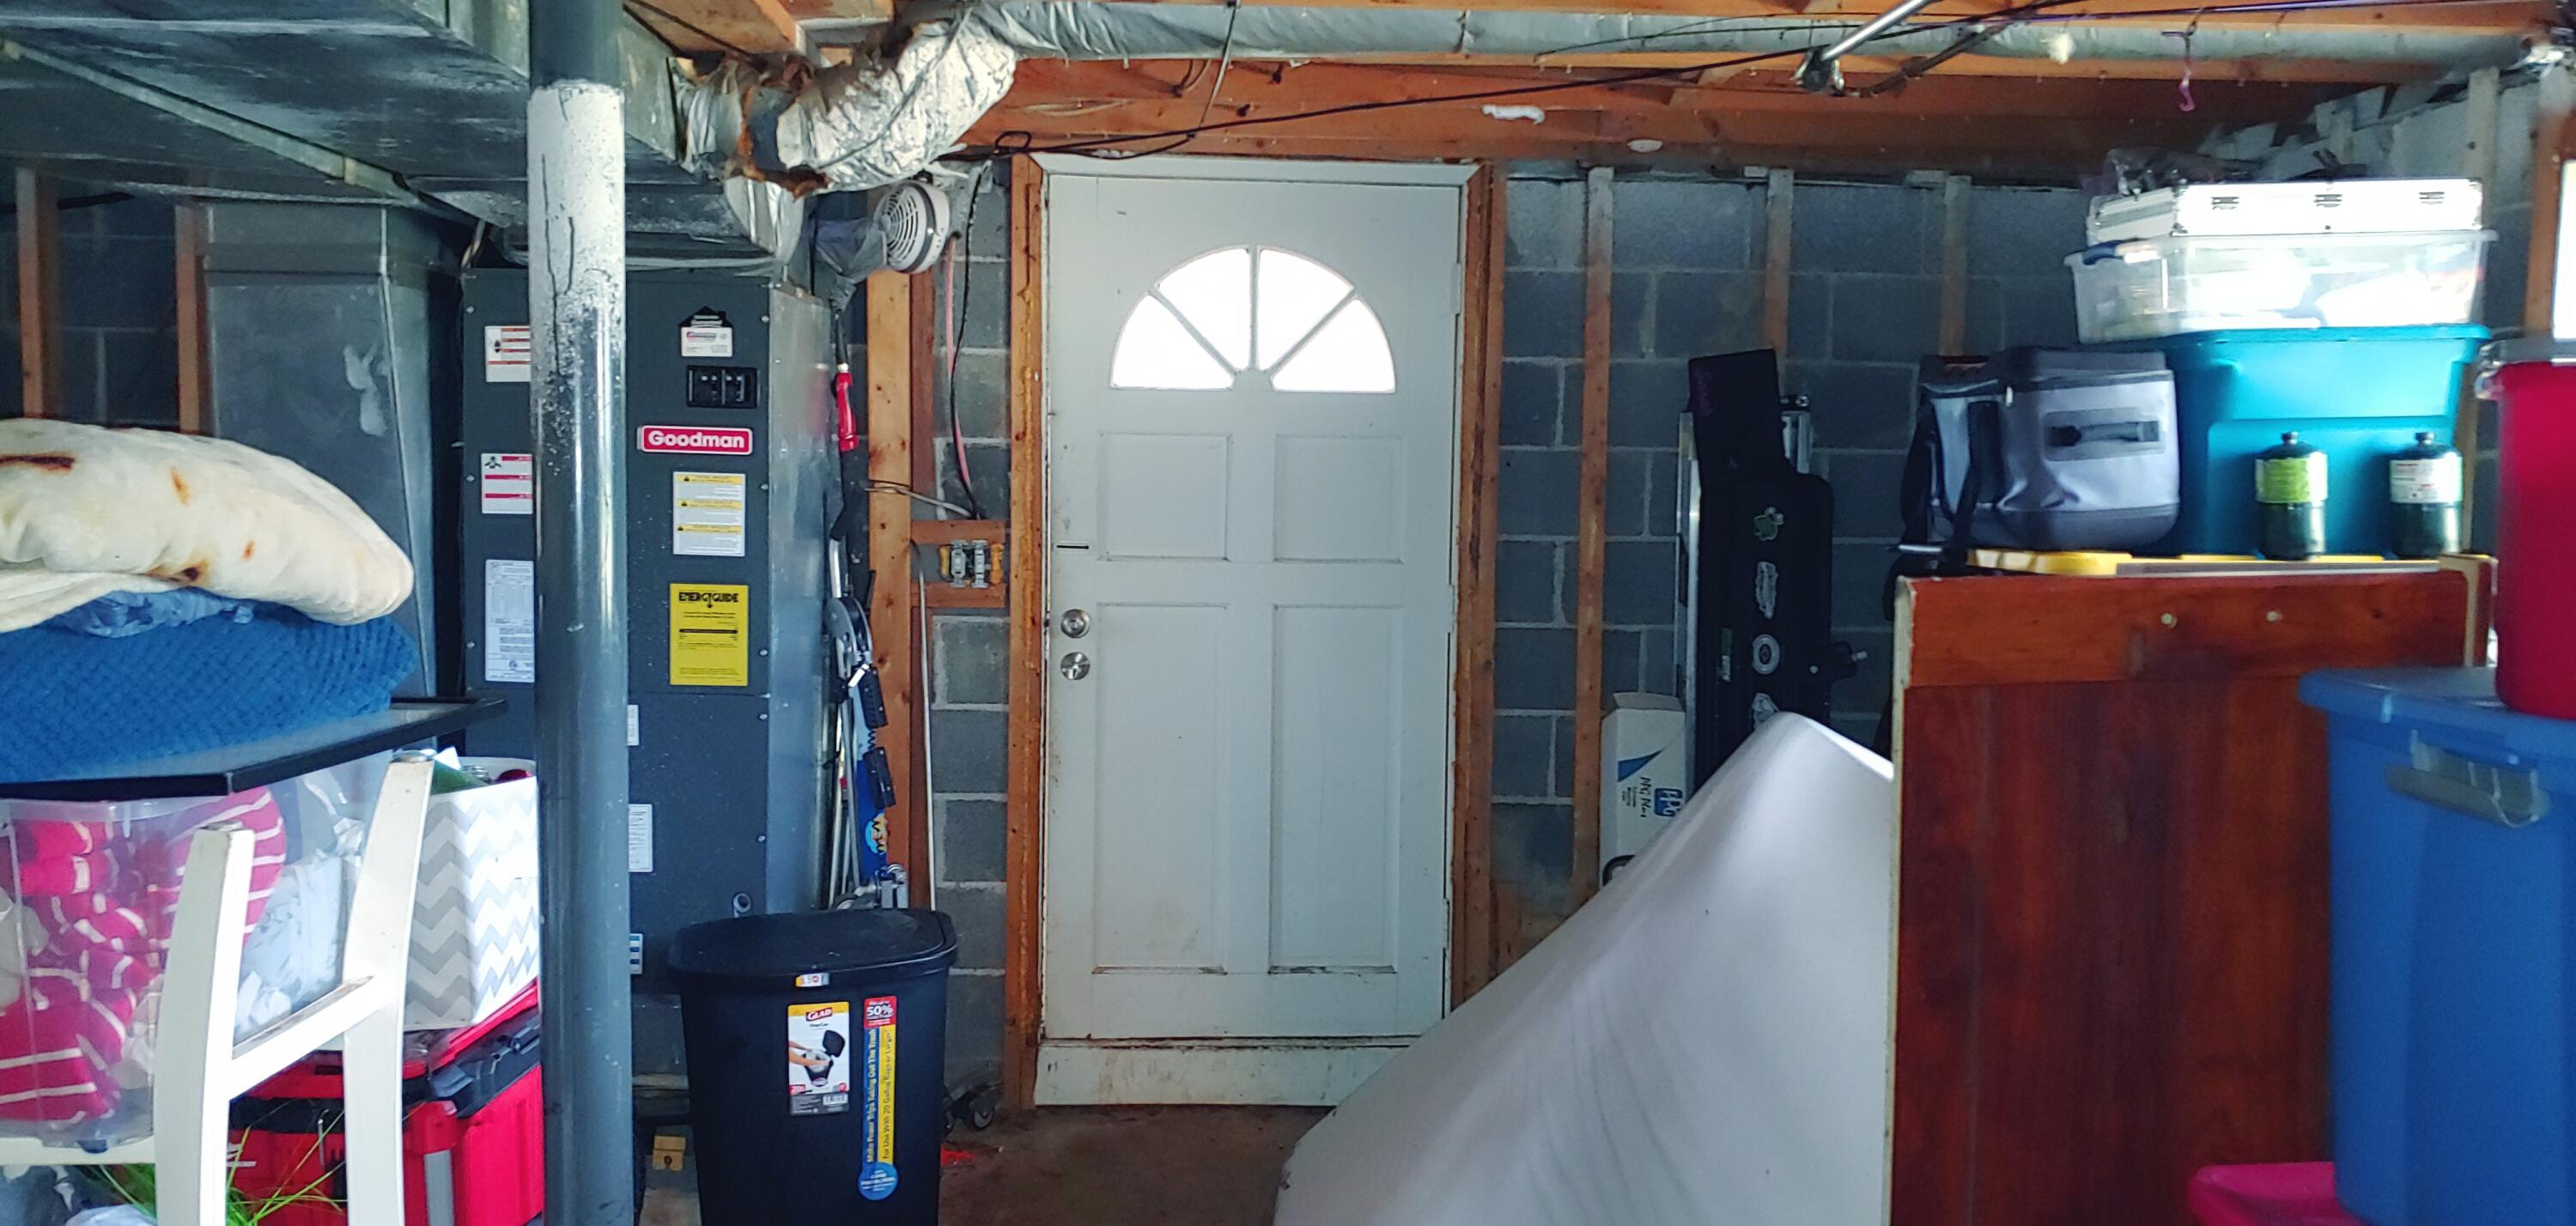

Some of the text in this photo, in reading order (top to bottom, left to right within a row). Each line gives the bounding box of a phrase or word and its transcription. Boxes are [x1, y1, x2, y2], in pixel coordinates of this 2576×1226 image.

[648, 430, 744, 448] Goodman
[807, 1009, 832, 1021] GLAD
[866, 1004, 893, 1017] 50%
